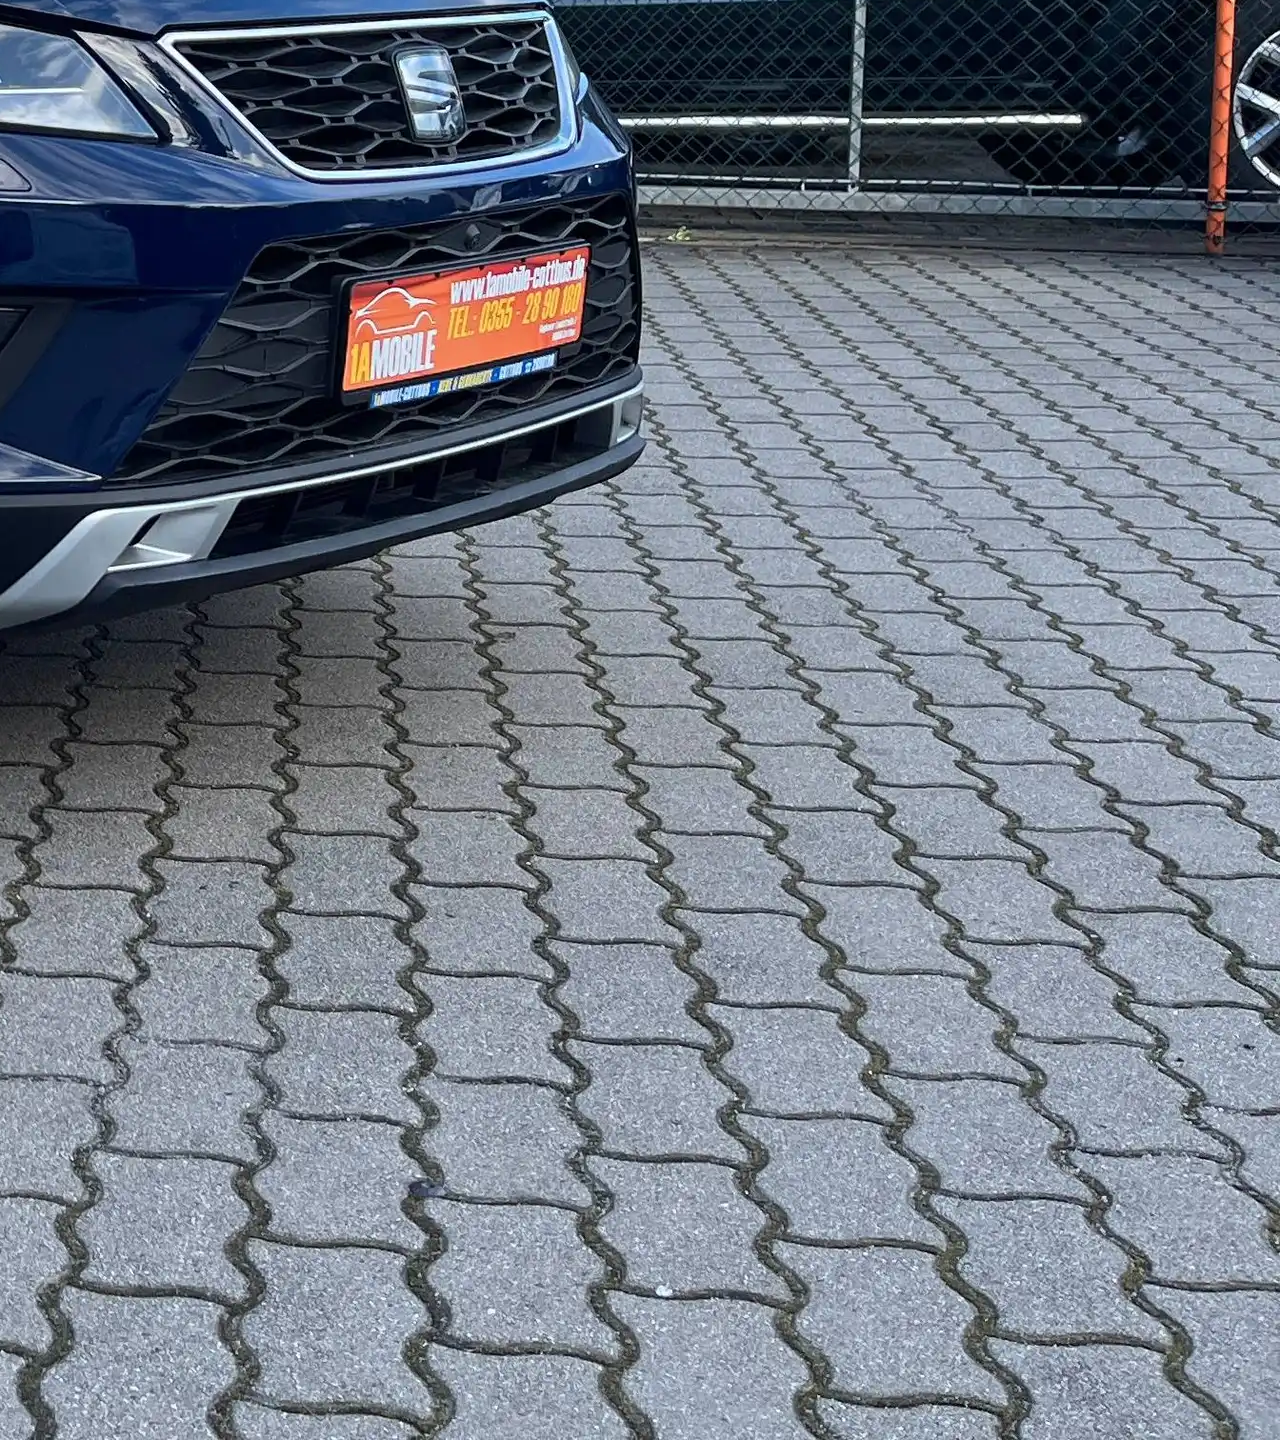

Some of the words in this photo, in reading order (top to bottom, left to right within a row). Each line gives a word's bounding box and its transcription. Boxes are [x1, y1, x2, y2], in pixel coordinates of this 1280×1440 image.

[450, 254, 586, 305] www.1amobile-cottbus.de
[478, 296, 516, 334] 0355
[521, 291, 542, 325] 28
[541, 287, 561, 320] 90
[349, 329, 438, 385] 1AMOBILE
